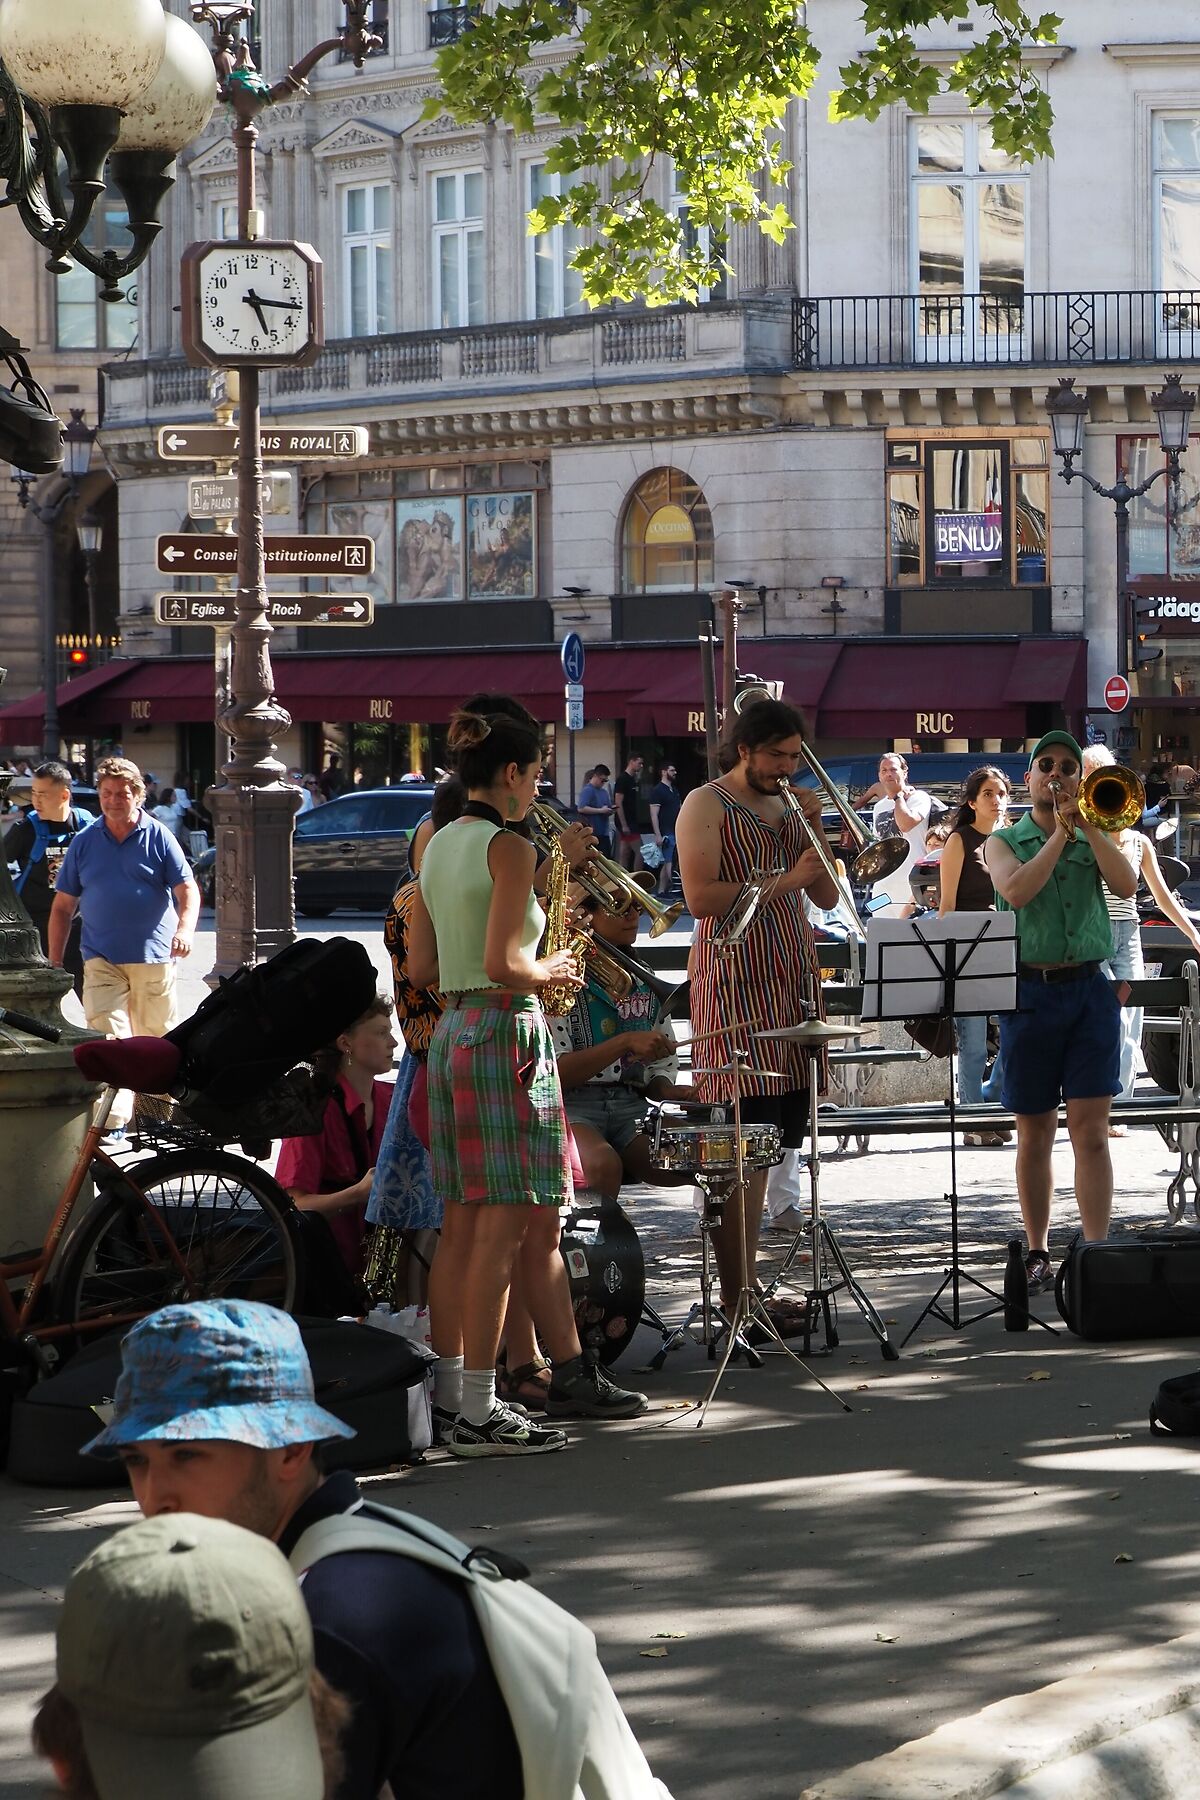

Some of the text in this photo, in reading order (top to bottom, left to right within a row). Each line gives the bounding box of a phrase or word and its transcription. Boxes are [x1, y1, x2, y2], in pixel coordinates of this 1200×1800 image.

[228, 263, 238, 275] 11
[245, 256, 258, 270] 12
[270, 264, 275, 275] 1
[214, 277, 227, 289] 10
[283, 277, 291, 289] 2
[210, 296, 218, 308] 9
[216, 316, 224, 327] 8
[284, 316, 293, 327] 4
[232, 329, 240, 340] 7
[270, 329, 278, 341] 5
[251, 335, 259, 347] 6
[233, 436, 332, 449] PAIS ROYAL
[211, 498, 232, 510] PALAIS
[193, 548, 342, 562] Consei nstitutionnel
[191, 602, 225, 617] Eglise
[131, 701, 151, 719] RUC
[370, 699, 393, 718] RUC
[915, 712, 954, 734] RUC
